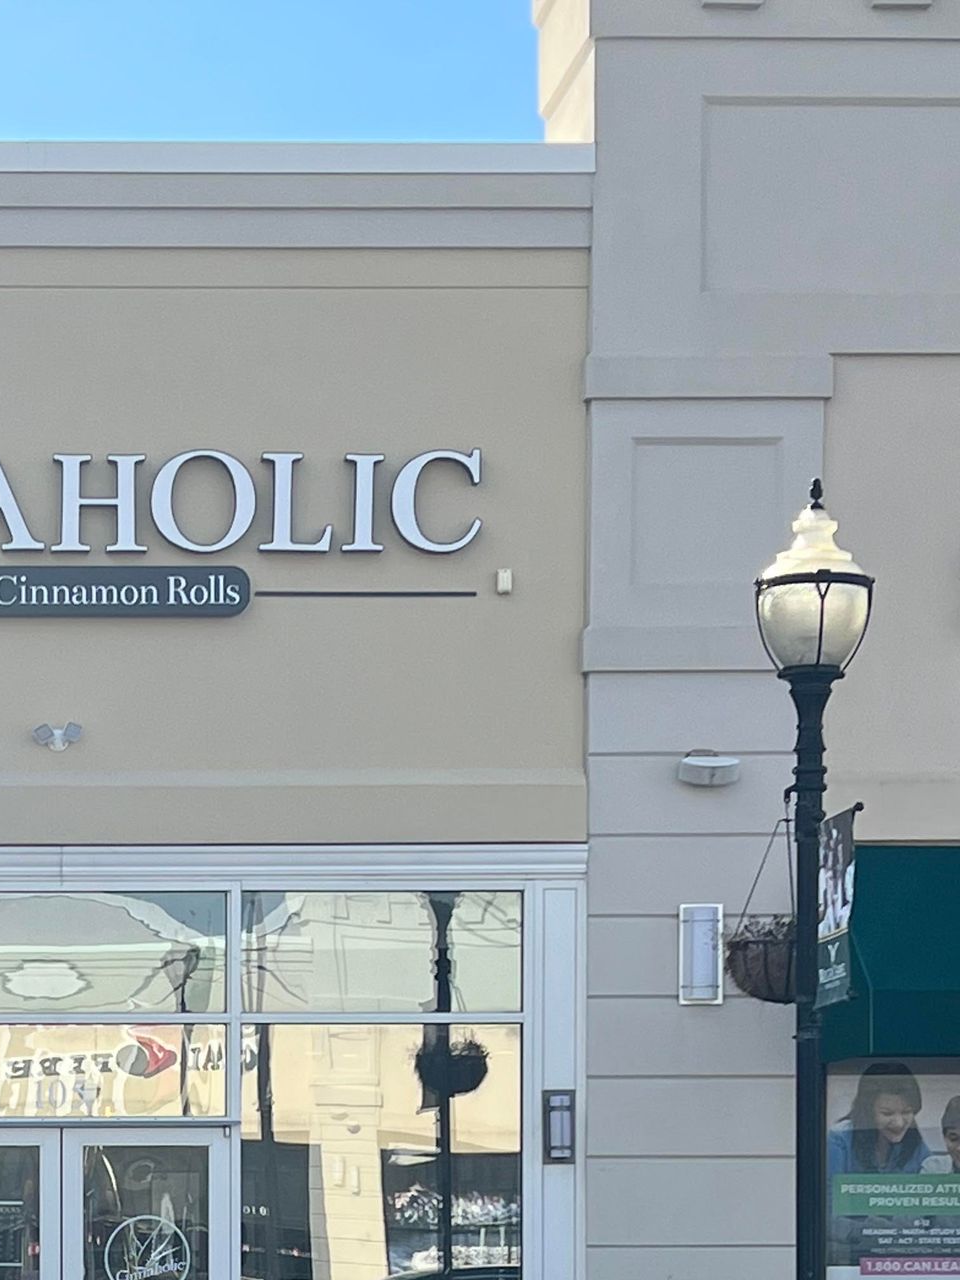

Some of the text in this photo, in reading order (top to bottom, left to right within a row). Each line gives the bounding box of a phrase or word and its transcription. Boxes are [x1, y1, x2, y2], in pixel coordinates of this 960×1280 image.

[167, 574, 241, 608] Rolls
[841, 1184, 934, 1194] PERSONALIZED
[869, 1197, 919, 1207] PROVEN
